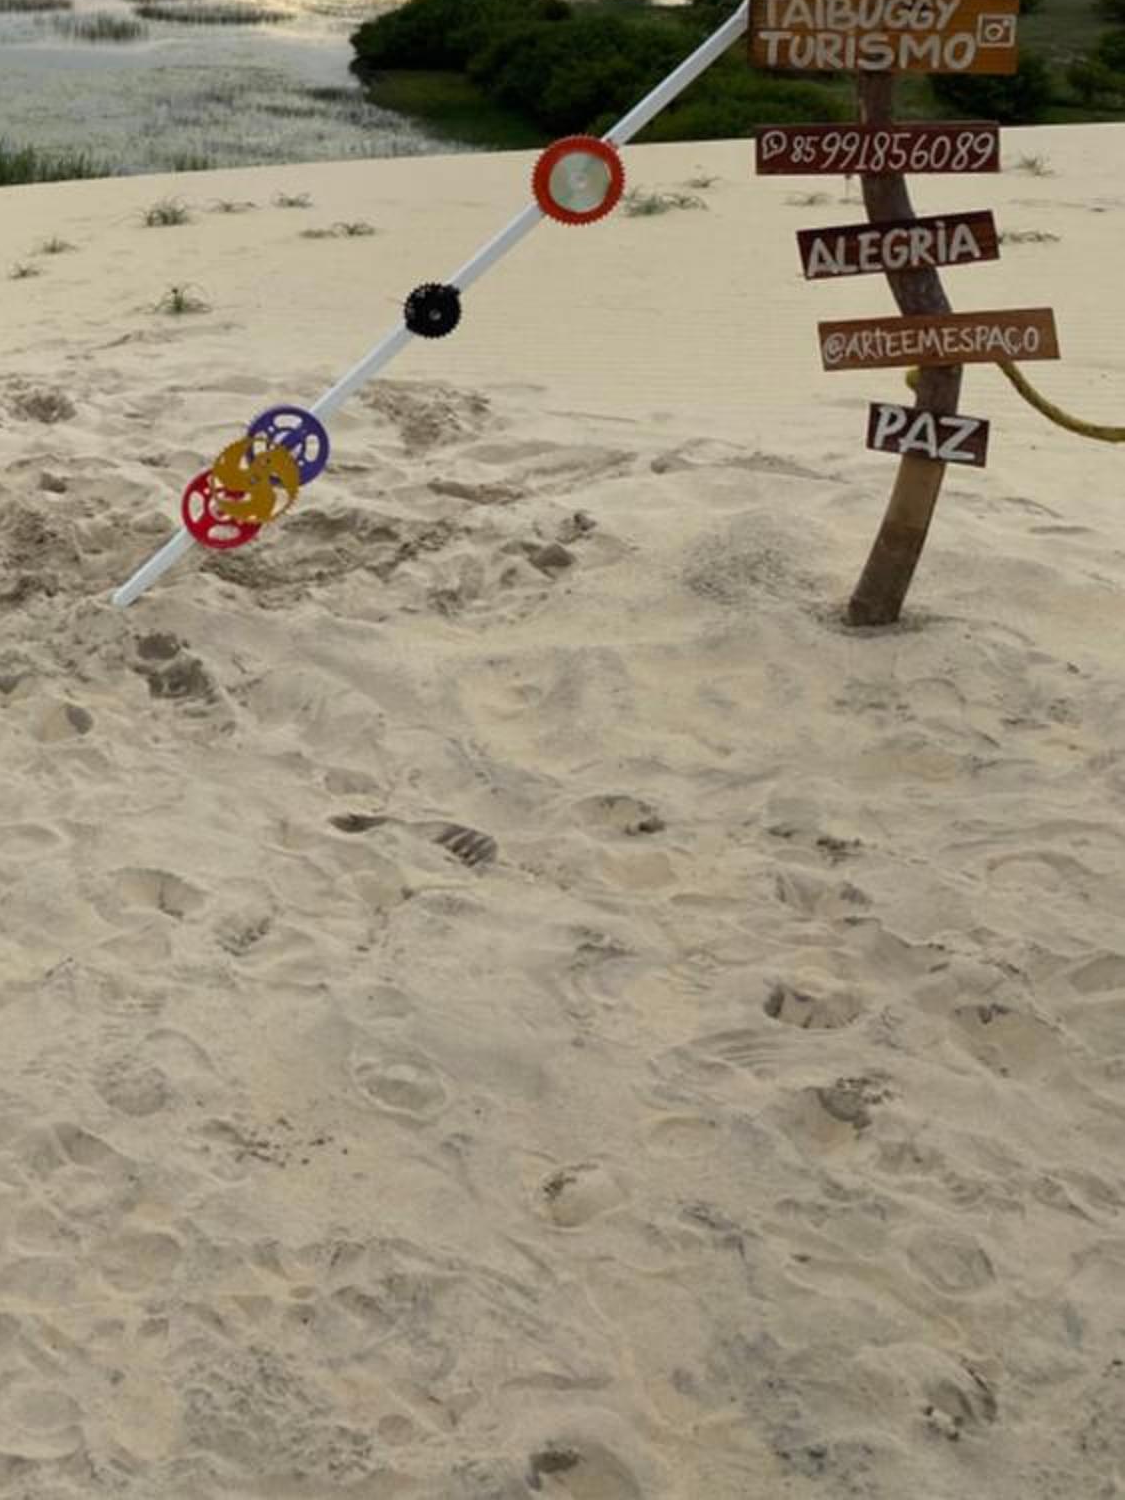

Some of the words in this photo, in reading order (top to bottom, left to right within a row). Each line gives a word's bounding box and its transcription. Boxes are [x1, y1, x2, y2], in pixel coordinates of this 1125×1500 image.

[758, 30, 976, 71] TURISMO
[806, 221, 981, 277] ALEGRIA
[874, 404, 979, 460] PAZ
